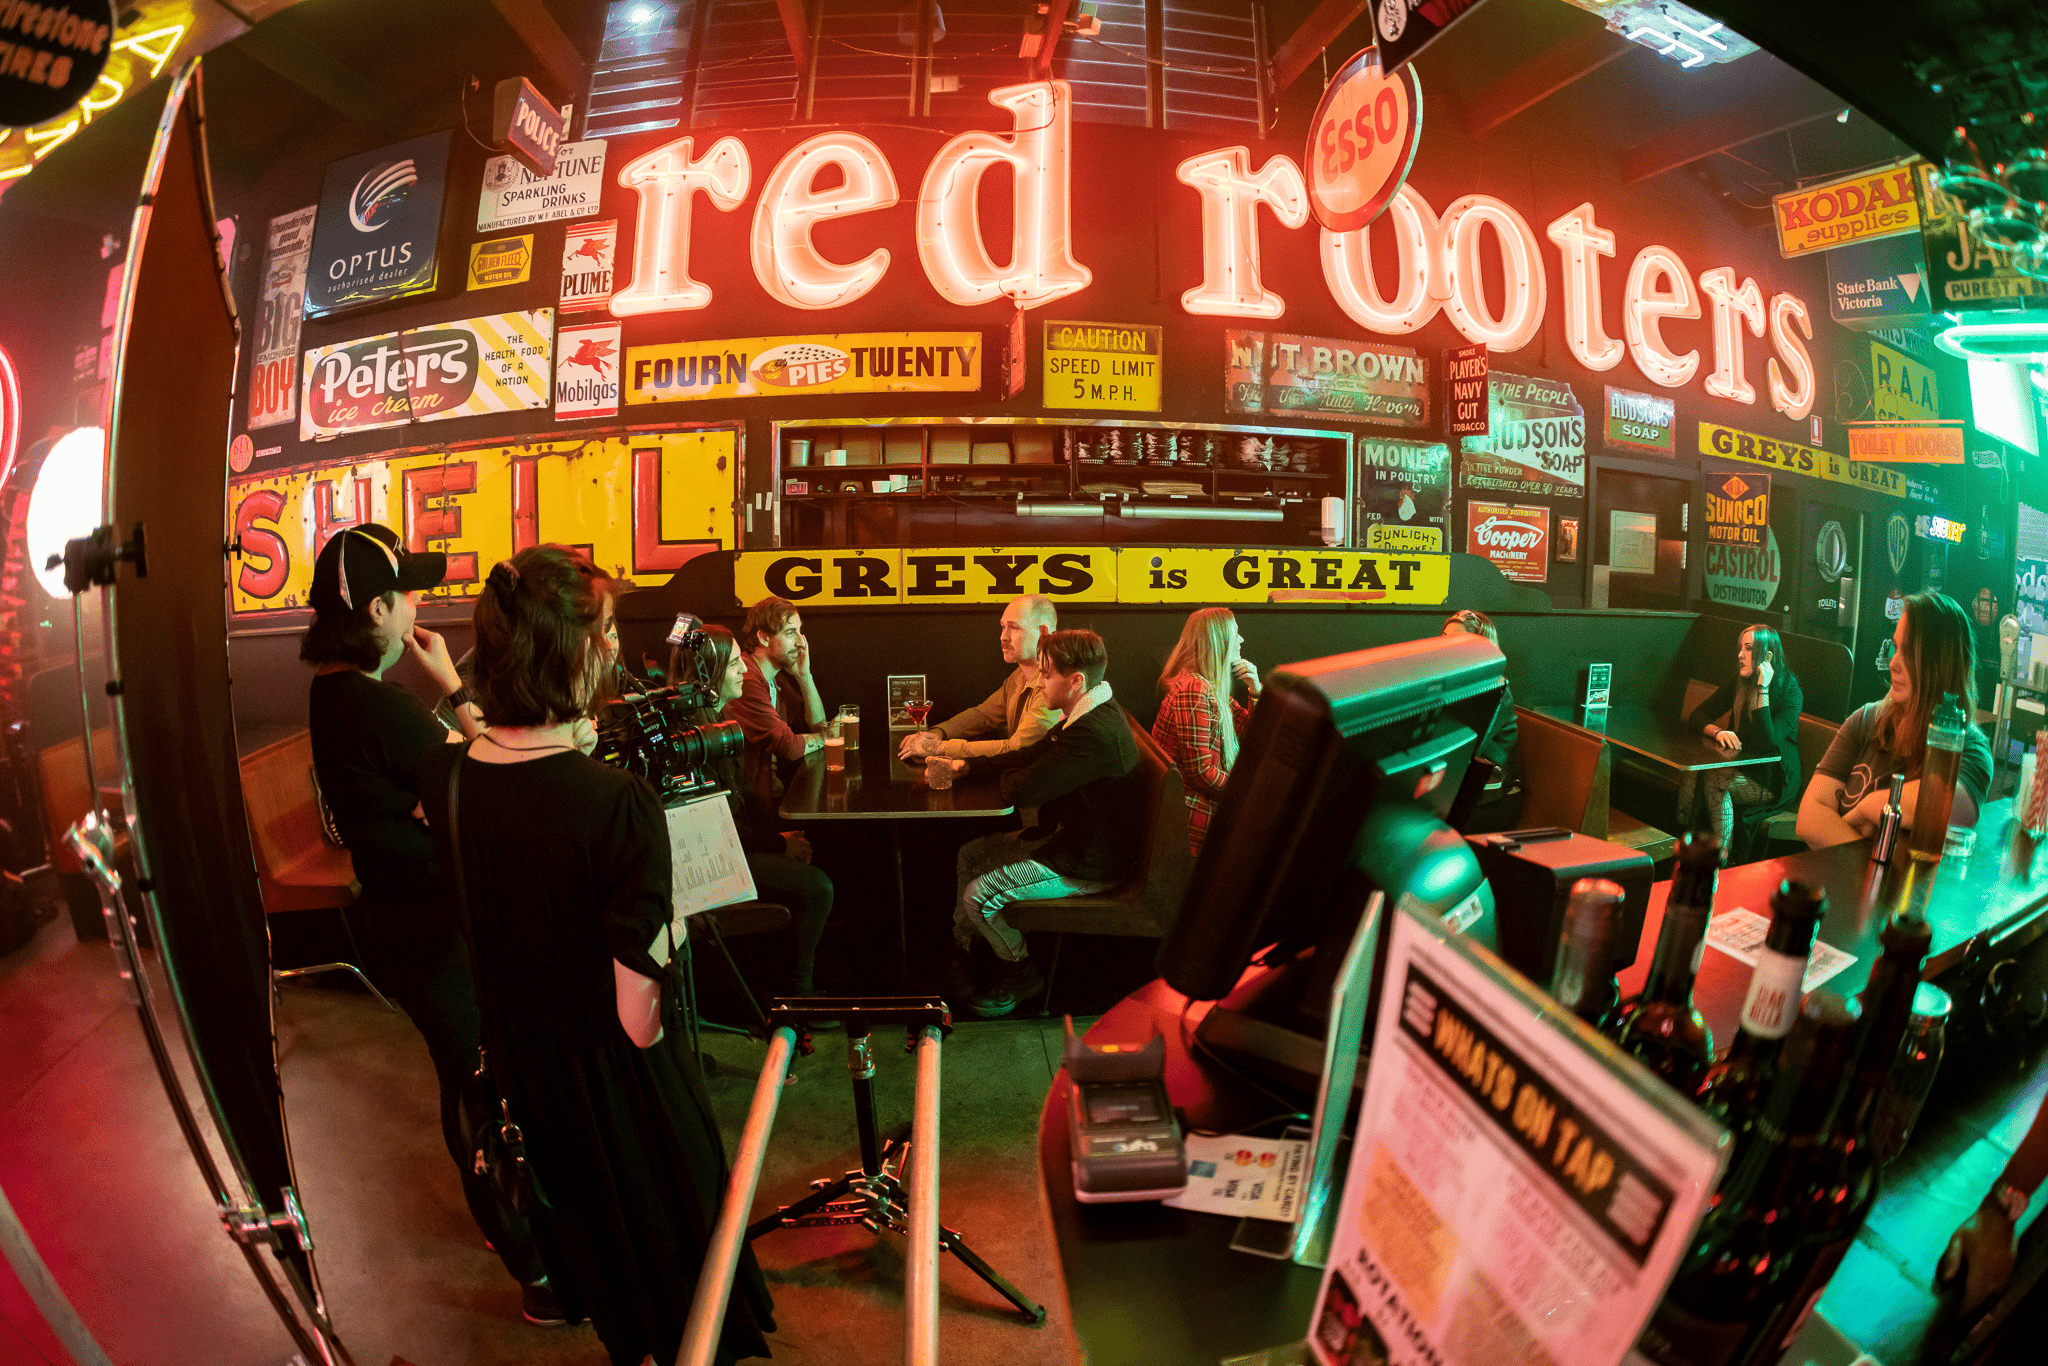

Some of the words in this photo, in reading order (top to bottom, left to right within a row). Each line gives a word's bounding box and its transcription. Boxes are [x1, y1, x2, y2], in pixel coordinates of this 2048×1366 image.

[516, 102, 560, 157] POLICE
[520, 156, 602, 185] NTUNE
[501, 184, 567, 207] SPARKLING
[542, 192, 586, 208] DRINKS
[478, 216, 526, 231] MANUFACTURED
[527, 214, 537, 222] BY
[552, 210, 568, 218] ABEL
[1806, 209, 1909, 244] supplies
[278, 227, 301, 246] good
[607, 79, 1094, 318] red
[1175, 145, 1815, 421] rooters
[329, 242, 412, 280] OPTUS
[477, 255, 500, 272] GOLDEN
[501, 251, 522, 267] FLEECE
[327, 275, 375, 293] authorised
[378, 267, 408, 282] dealer
[484, 272, 502, 282] MOTOR
[562, 270, 611, 297] PLUME
[1837, 279, 1865, 295] State
[1866, 276, 1898, 292] Bank
[1837, 296, 1883, 311] Victoria
[261, 291, 301, 351] BIG
[507, 335, 524, 344] THE
[1060, 327, 1146, 352] CAUTION
[256, 346, 296, 363] LEMONADE
[485, 350, 516, 361] HEALTH
[521, 346, 544, 356] FOOD
[850, 346, 976, 378] TWENTY
[1458, 348, 1476, 358] SMOKE
[320, 338, 468, 403] Peters
[501, 363, 512, 373] OF
[517, 362, 524, 371] A
[788, 359, 847, 386] PIES
[1050, 357, 1100, 375] SPEED
[1112, 360, 1155, 377] LIMIT
[1312, 347, 1424, 384] BROWN
[1450, 356, 1487, 380] PLAYER'S
[251, 357, 294, 418] BOY
[495, 375, 529, 387] NATION
[1073, 379, 1085, 399] 5
[1454, 381, 1482, 400] NAVY
[1502, 382, 1523, 398] THE
[557, 379, 618, 406] Mobilgas
[327, 399, 359, 423] ice
[371, 392, 444, 416] cream
[1457, 402, 1478, 420] CUT
[1453, 421, 1485, 432] TOBACCO
[1622, 424, 1659, 440] SOAP
[1850, 433, 1898, 456] TOILET
[1905, 433, 1961, 457] ROOMS
[1365, 444, 1449, 471] MONEY
[1541, 451, 1585, 473] SOAP
[1711, 428, 1814, 472] GREYS
[1829, 456, 1840, 475] is
[1849, 461, 1900, 490] GREAT
[1375, 470, 1387, 480] IN
[1390, 471, 1438, 484] POULTRY
[1477, 464, 1492, 473] FINE
[1494, 465, 1523, 476] POWDER
[1466, 475, 1518, 489] ESTABLISHED
[1520, 480, 1541, 490] OVER
[1366, 512, 1381, 520] FED
[1478, 506, 1509, 515] AUTHORISED
[1509, 508, 1541, 517] DISTRIBUTOR
[1705, 491, 1767, 526] SUNOCO
[236, 446, 722, 600] SHELL
[1474, 516, 1544, 550] Cooper
[1373, 530, 1438, 546] SUNLIGHT
[1708, 525, 1739, 541] MOTOR
[1742, 526, 1760, 543] OIL
[1489, 550, 1528, 560] MACHINERY
[1705, 544, 1778, 582] CASTROL
[764, 553, 1093, 599] GREYS
[1149, 556, 1188, 591] is
[1222, 556, 1422, 592] GREAT
[1712, 583, 1768, 606] DISTRIBUTOR
[1818, 598, 1837, 609] TOILETS
[1433, 1006, 1517, 1112] WHATS
[1511, 1083, 1557, 1149] ON
[1552, 1118, 1616, 1195] TAP
[1225, 1179, 1242, 1198] VISA
[1249, 1181, 1266, 1201] VISA
